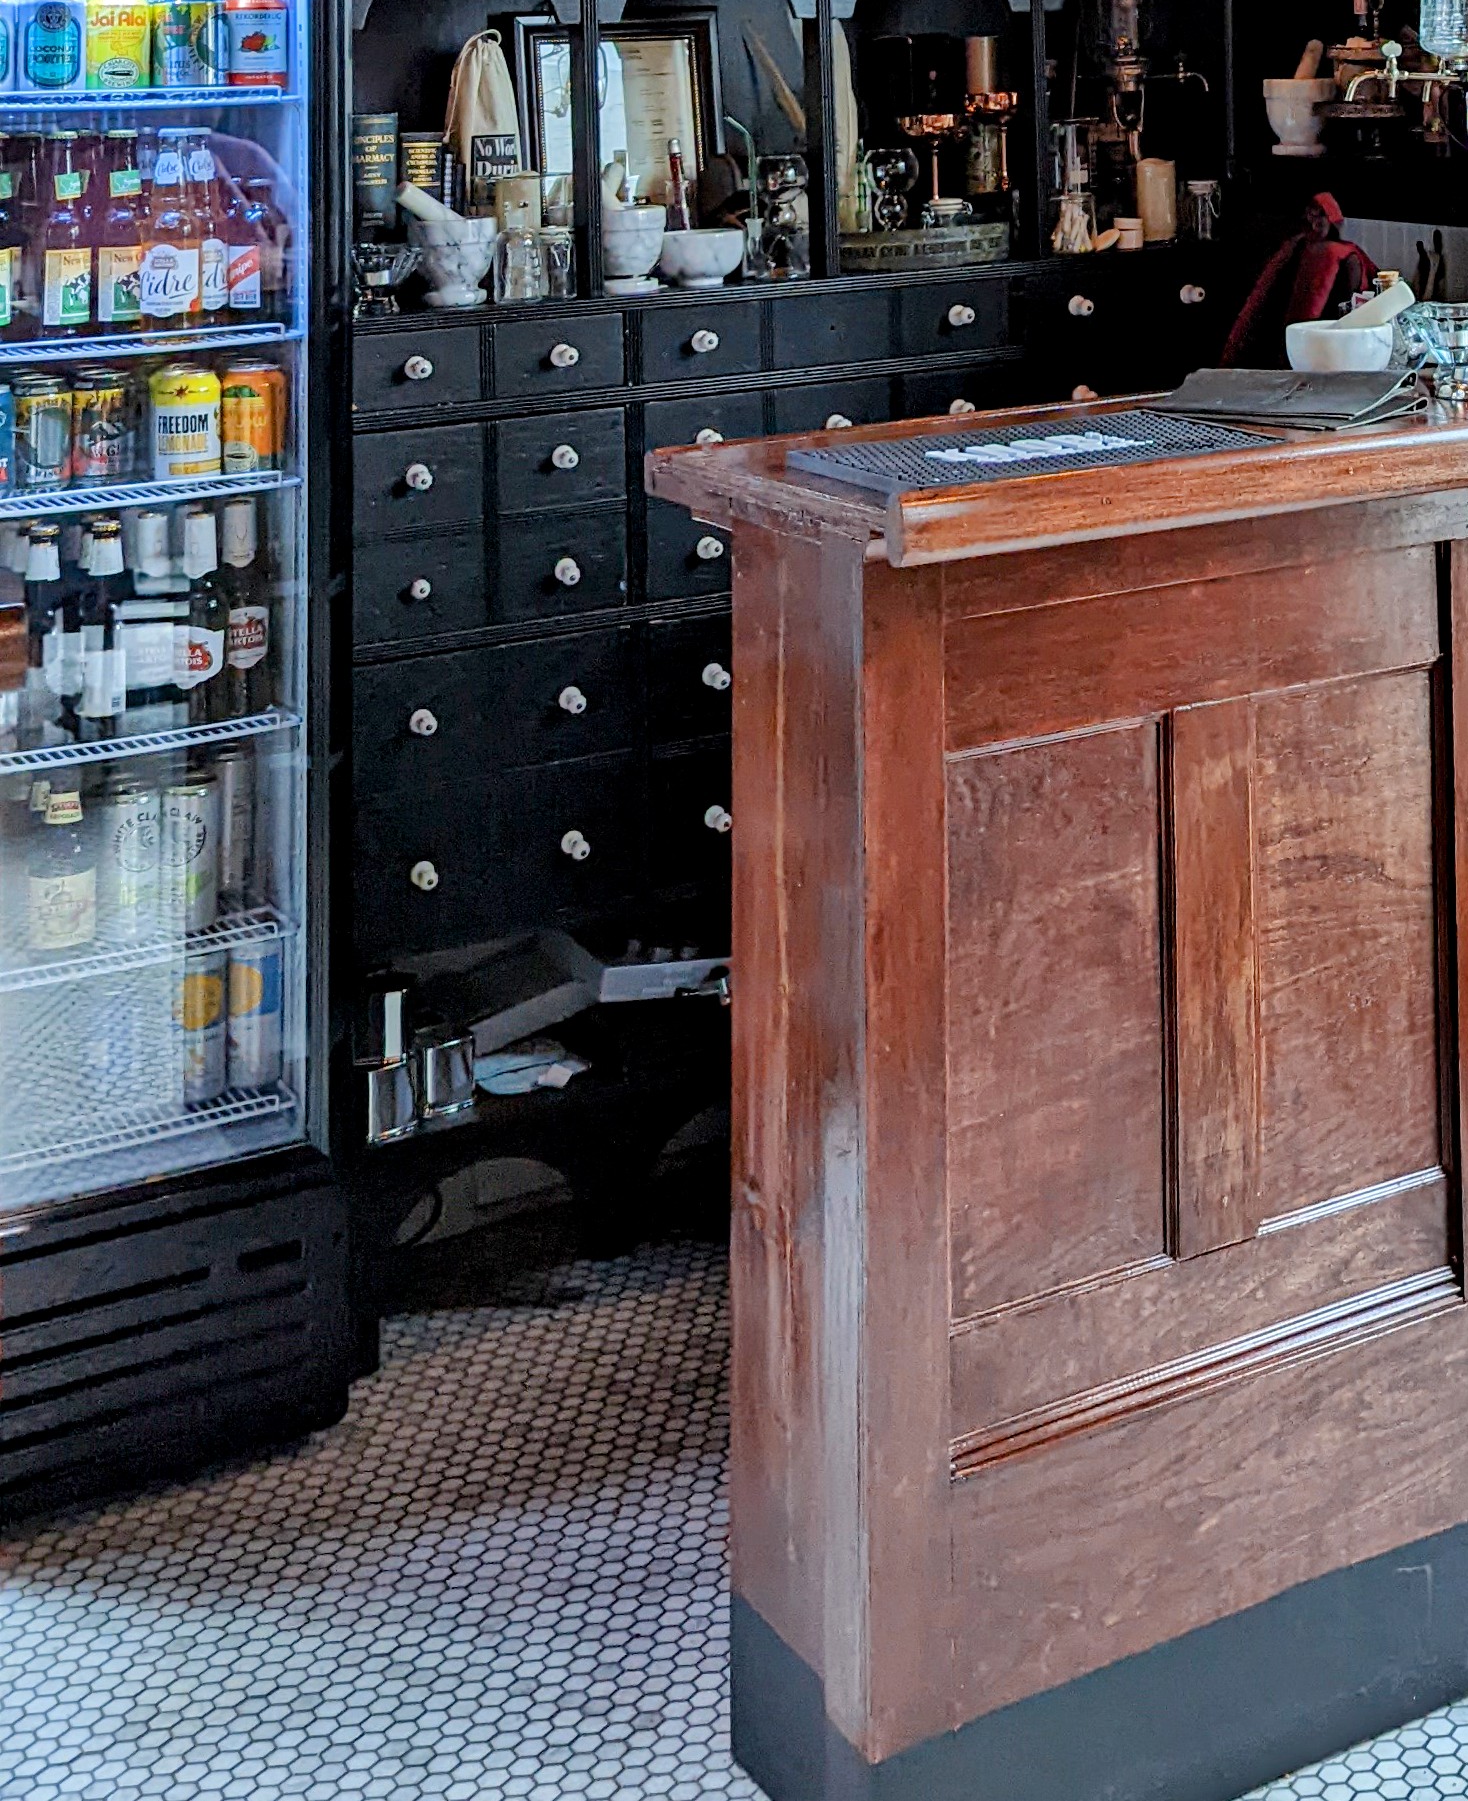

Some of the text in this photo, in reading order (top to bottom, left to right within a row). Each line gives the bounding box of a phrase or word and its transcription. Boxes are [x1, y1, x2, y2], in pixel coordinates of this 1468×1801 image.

[91, 11, 115, 27] Jai
[118, 11, 146, 26] Alai
[365, 145, 377, 153] OF
[475, 139, 492, 157] No
[158, 414, 208, 433] FREEDOM
